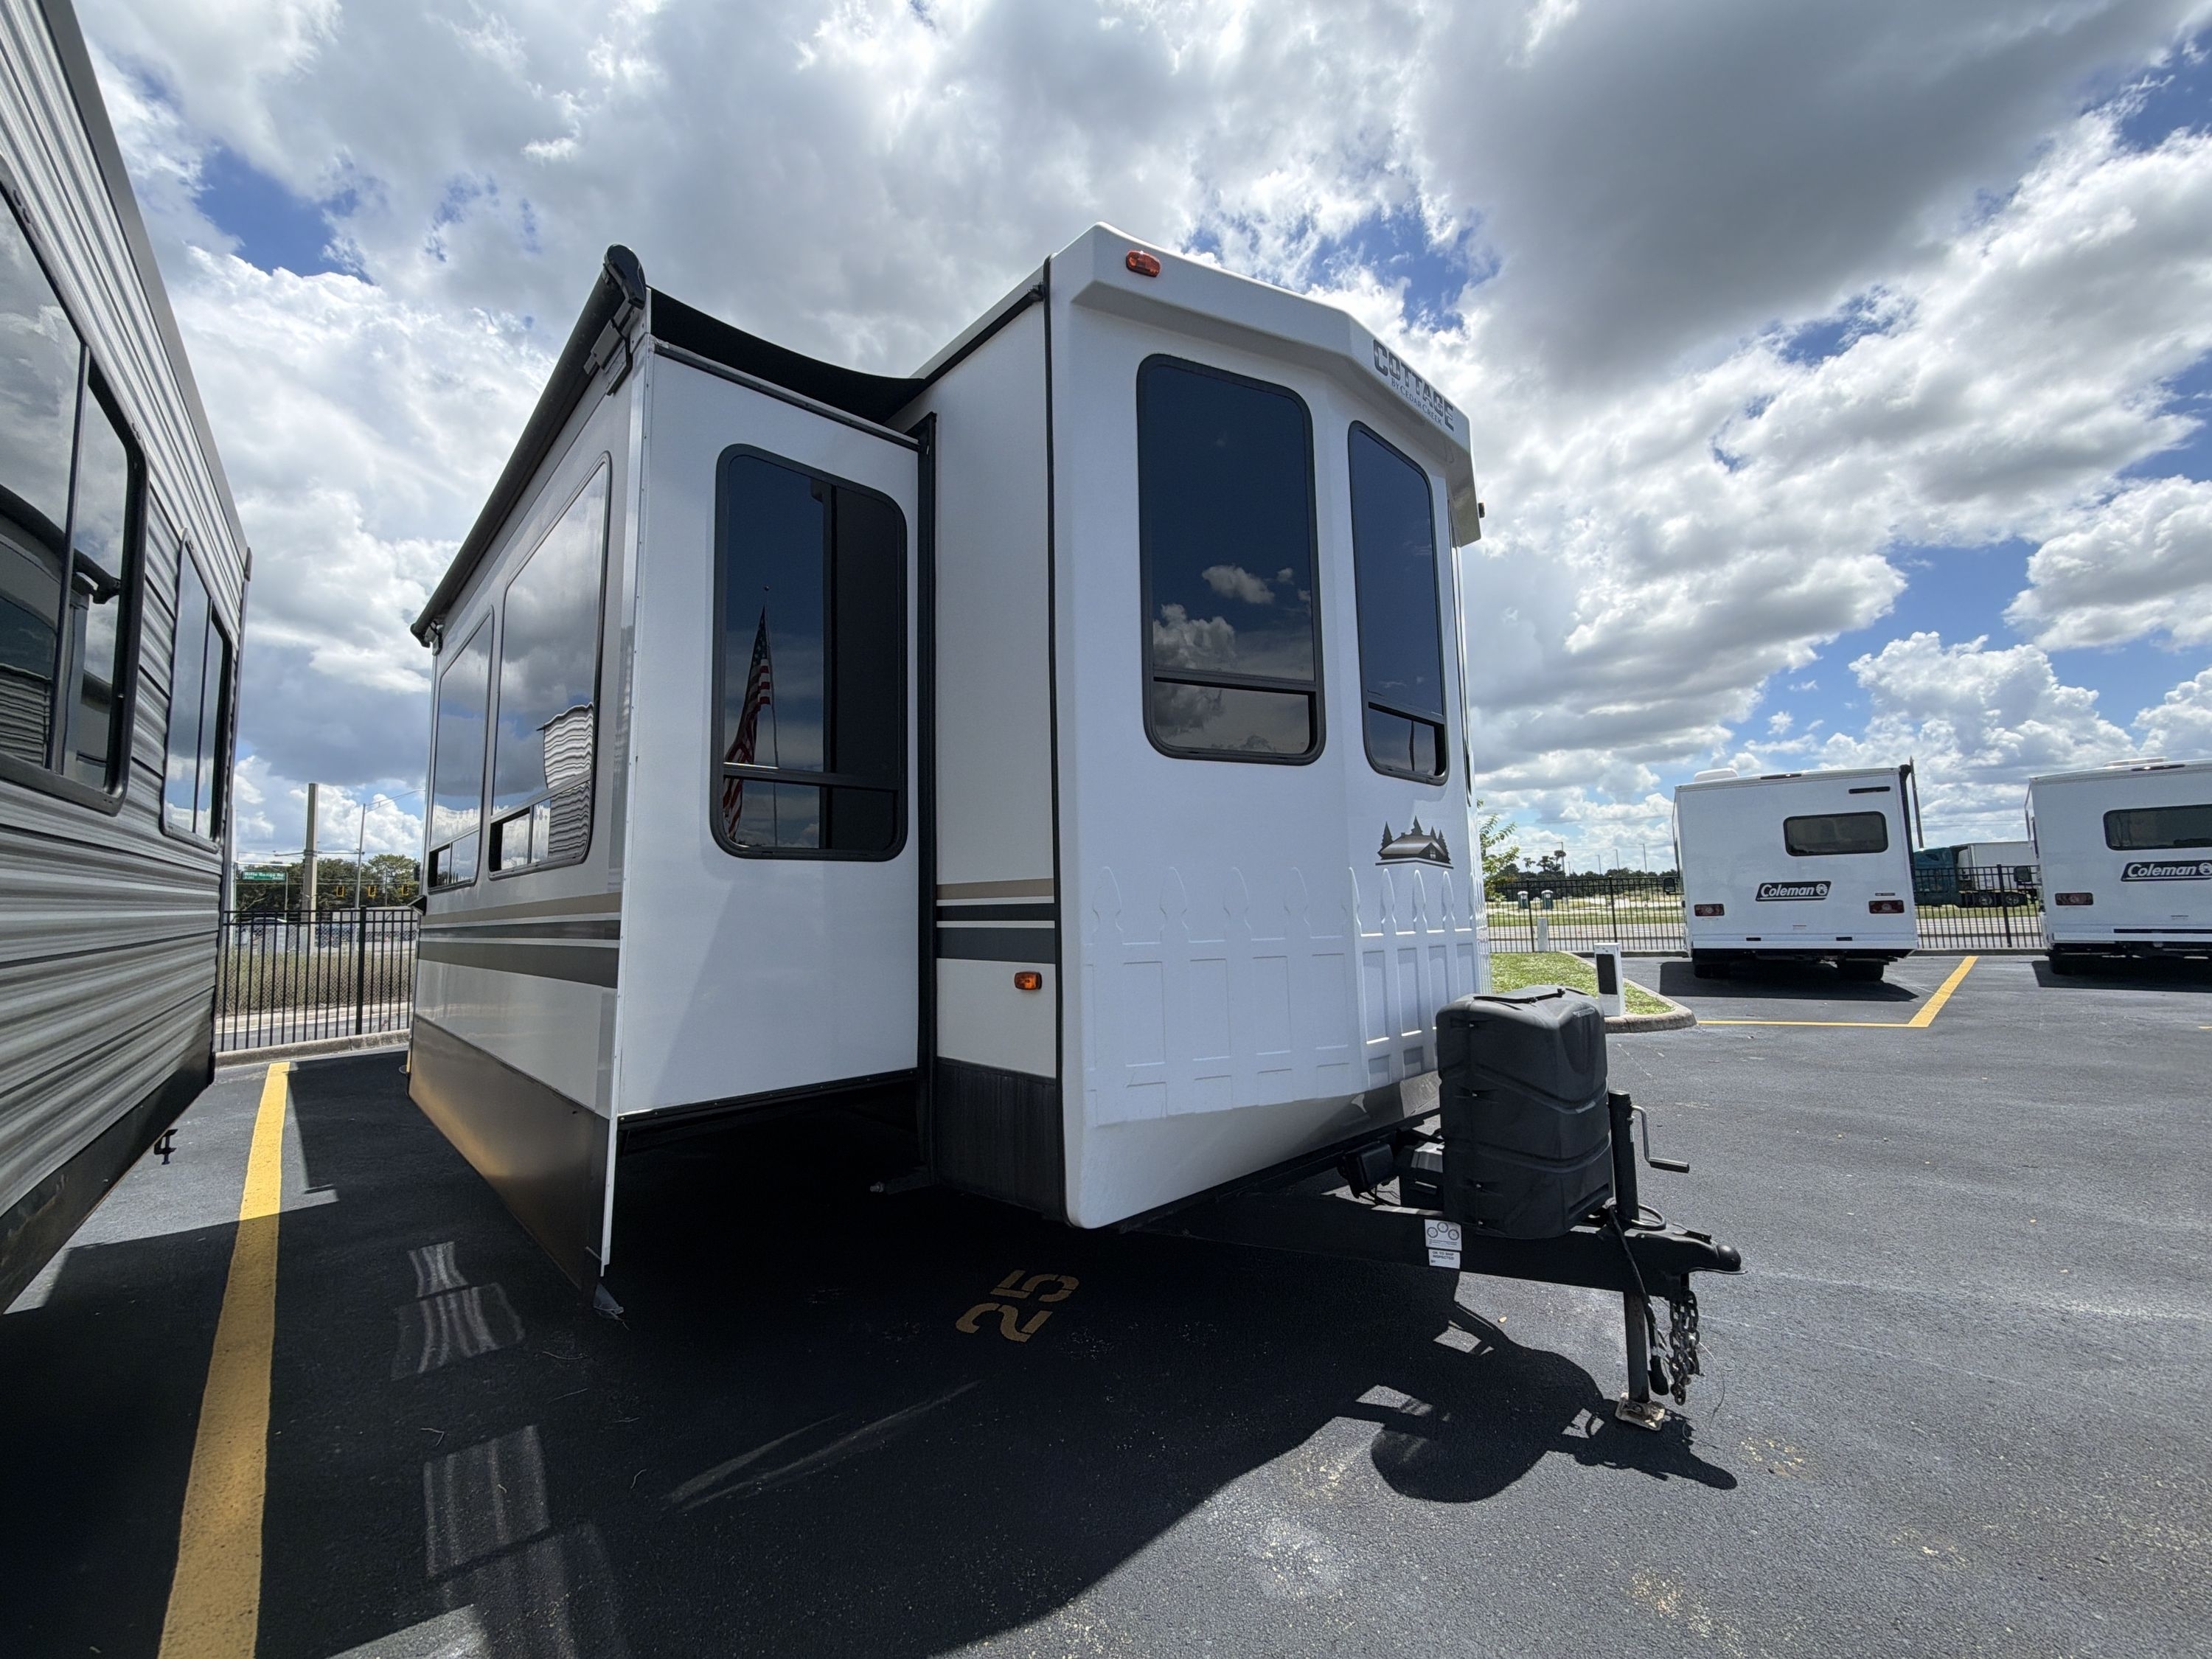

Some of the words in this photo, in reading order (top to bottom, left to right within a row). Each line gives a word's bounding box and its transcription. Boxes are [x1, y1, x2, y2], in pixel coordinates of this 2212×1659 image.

[1373, 339, 1454, 431] COTTAGE
[1391, 378, 1399, 389] BY
[1400, 385, 1422, 408] CEDAR
[1422, 404, 1442, 425] CREEK
[1761, 884, 1815, 897] Coleman
[2127, 863, 2197, 877] Coleman
[956, 1270, 1079, 1343] 25
